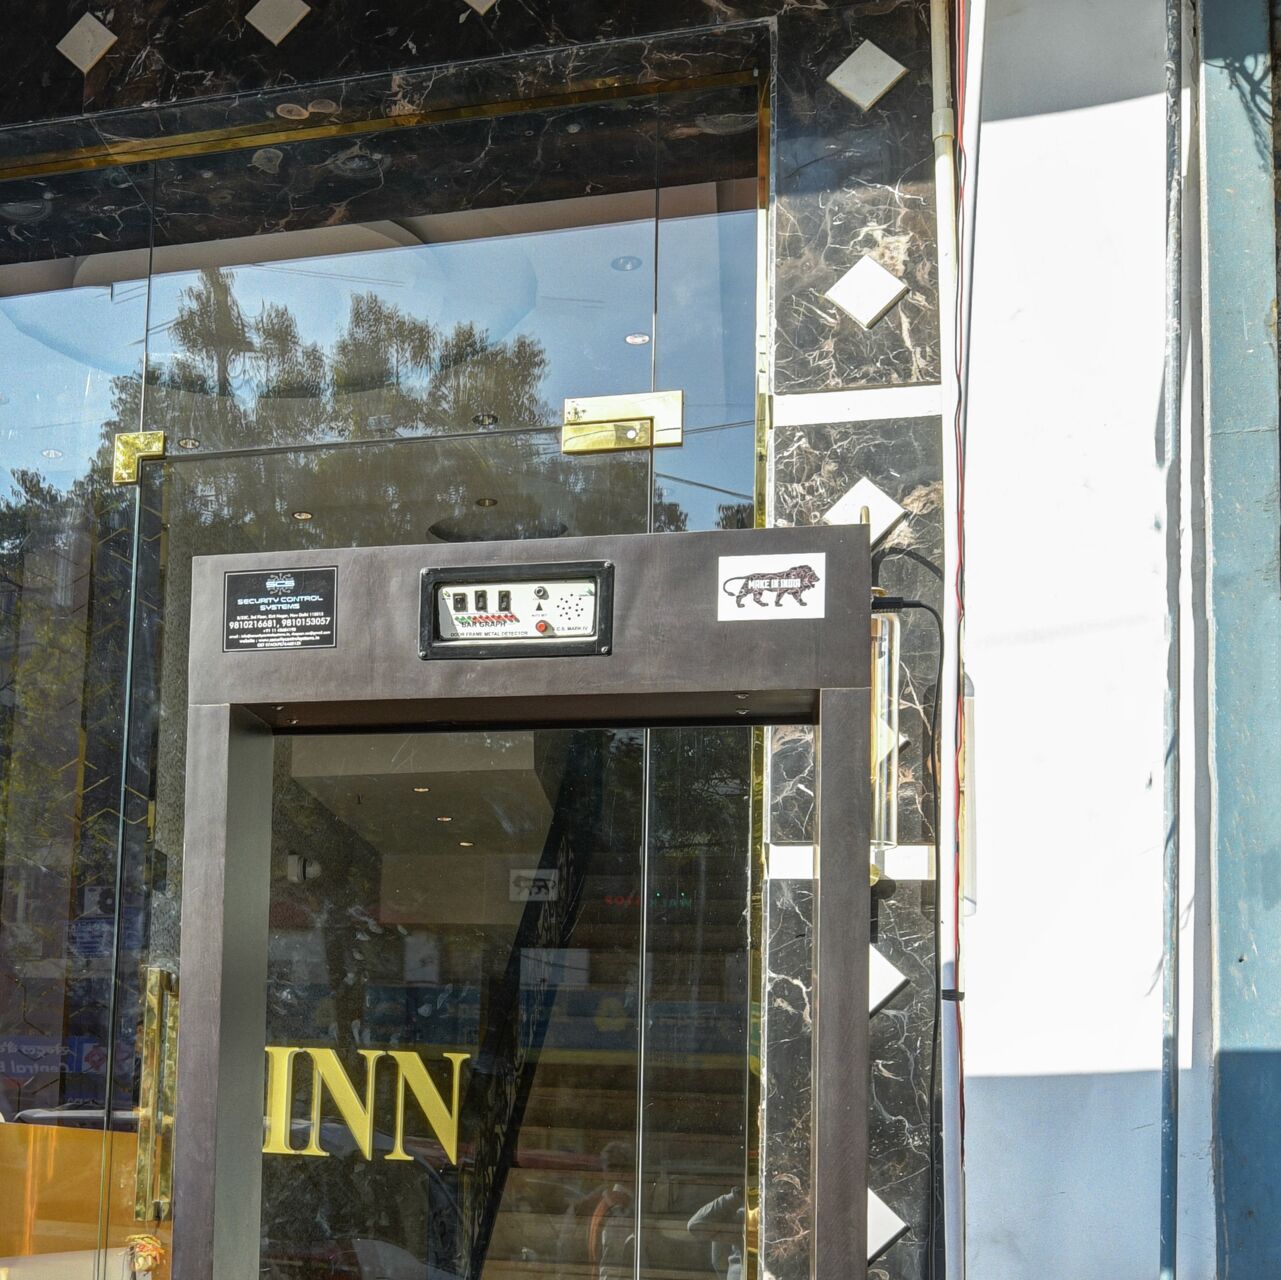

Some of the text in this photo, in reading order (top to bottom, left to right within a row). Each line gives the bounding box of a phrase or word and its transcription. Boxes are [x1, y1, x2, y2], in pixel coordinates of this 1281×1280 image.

[748, 579, 771, 589] MAKE
[237, 594, 324, 606] SECURITY CONTROL
[259, 602, 301, 612] SYSTEMS
[228, 619, 280, 630] 9810216681,
[281, 617, 331, 628] 9810153057
[461, 620, 507, 629] BAR GRAPH
[262, 1046, 471, 1166] INN
